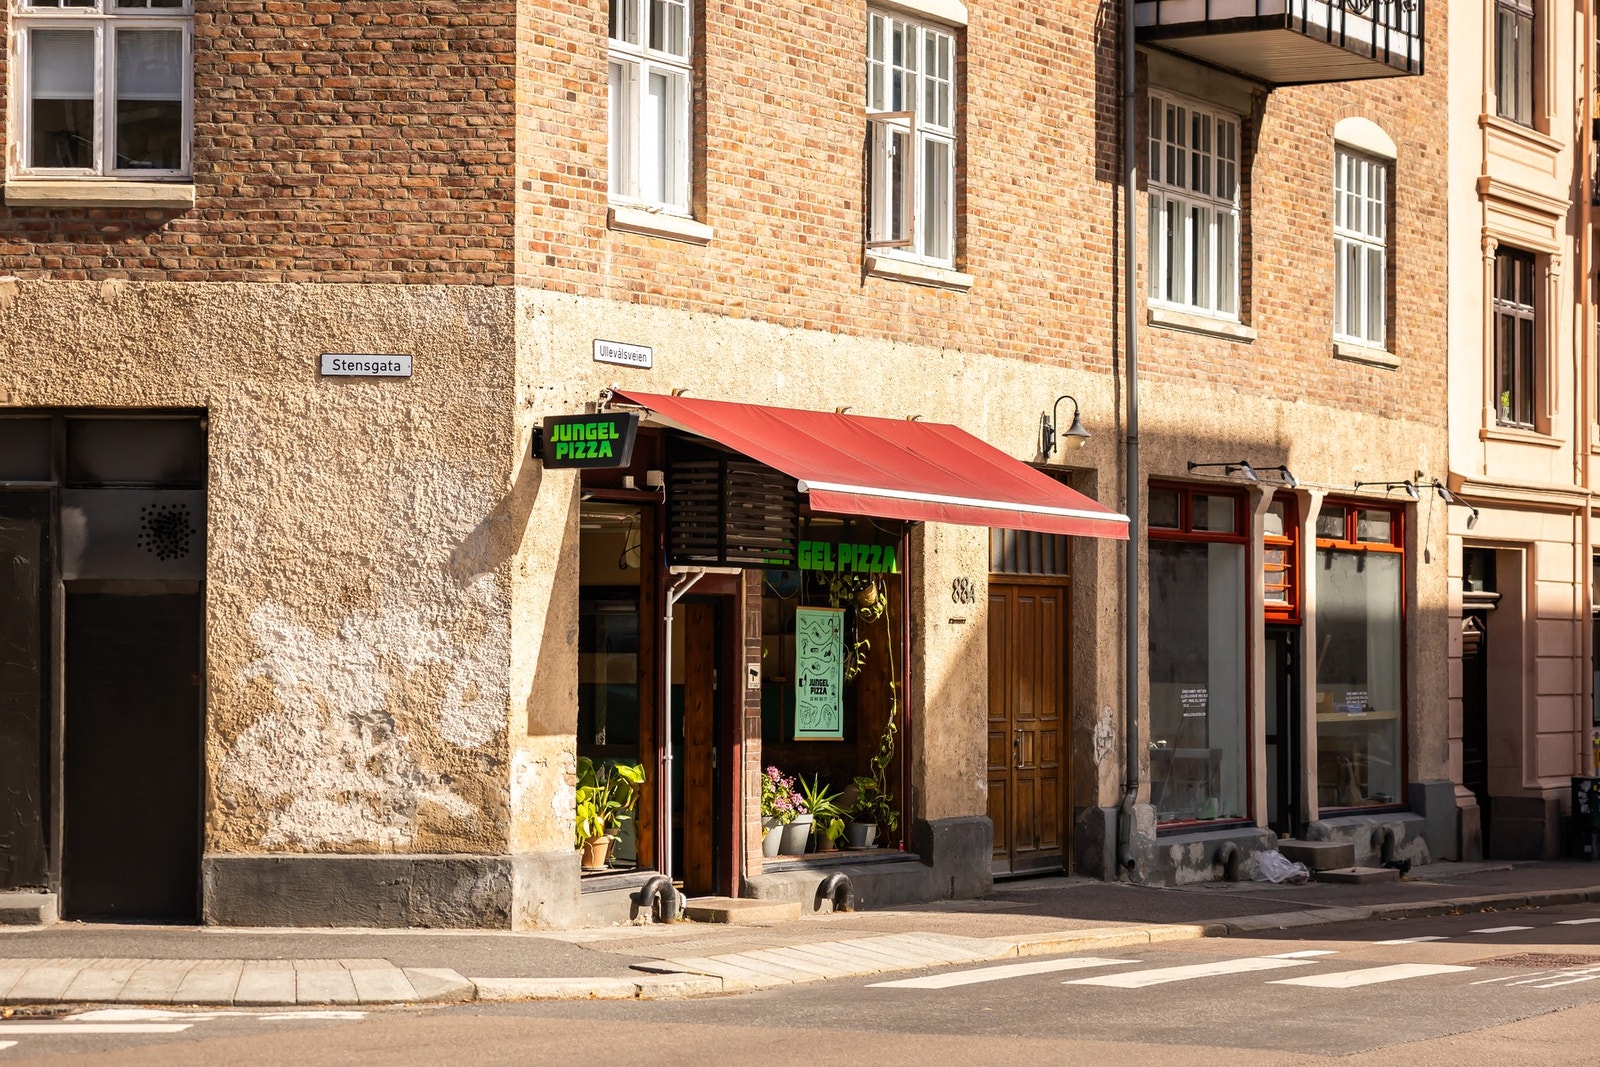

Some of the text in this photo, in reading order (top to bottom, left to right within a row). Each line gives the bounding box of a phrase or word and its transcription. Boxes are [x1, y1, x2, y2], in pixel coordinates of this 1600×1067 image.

[599, 345, 647, 362] Ullevålsveien
[332, 358, 401, 374] Stensgata
[550, 421, 620, 442] JUNGEL
[555, 440, 614, 460] PIZZA
[837, 543, 897, 574] PIZZA
[951, 576, 975, 604] 88A
[809, 678, 829, 687] JUNGEL
[810, 687, 827, 695] PIZZA
